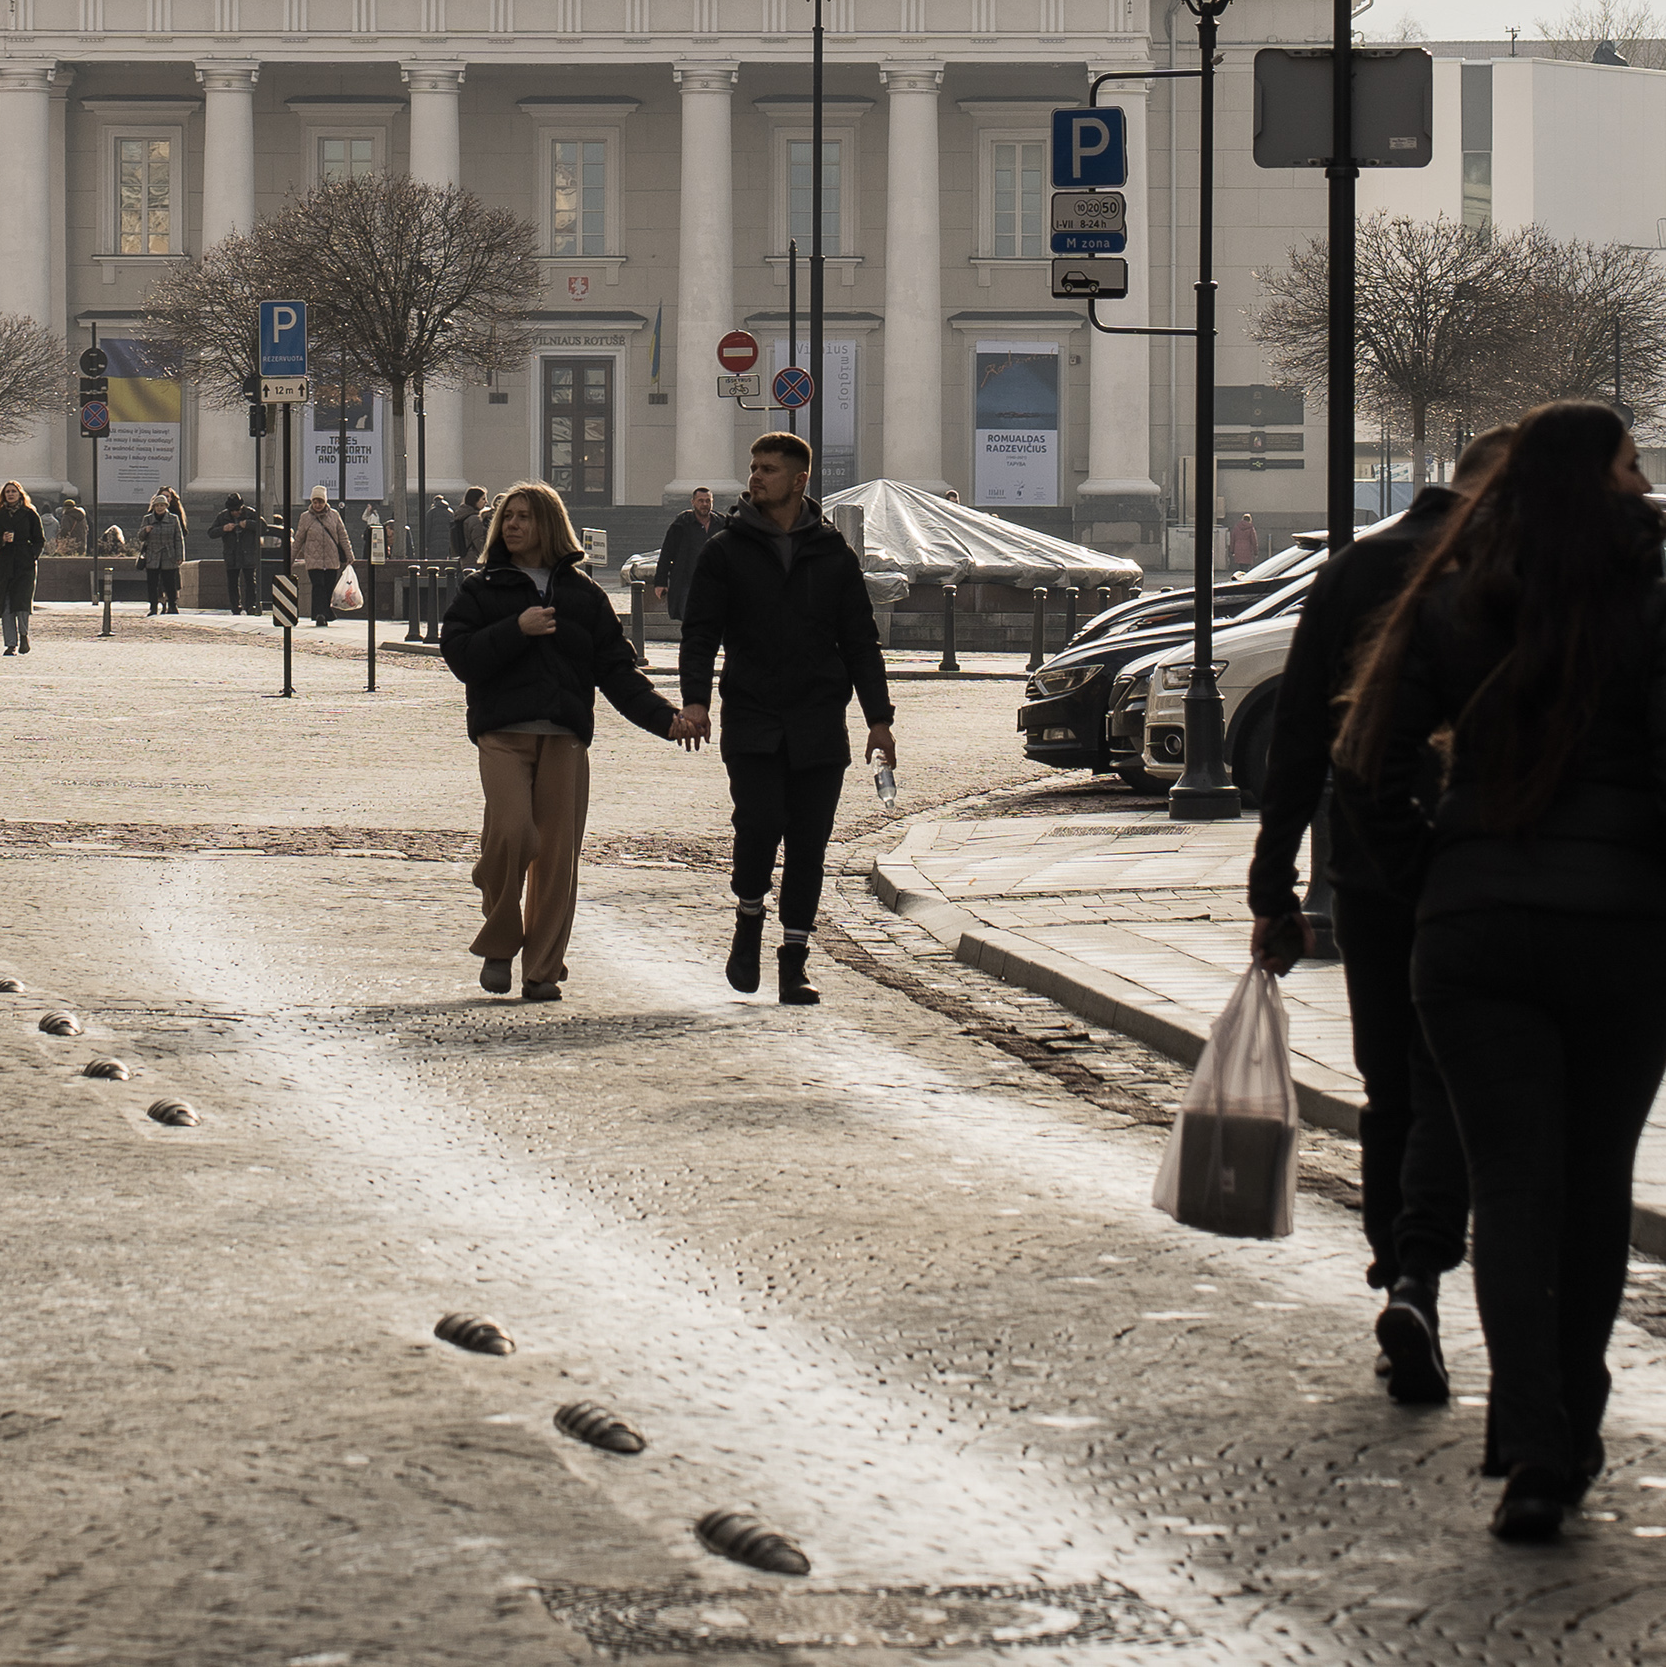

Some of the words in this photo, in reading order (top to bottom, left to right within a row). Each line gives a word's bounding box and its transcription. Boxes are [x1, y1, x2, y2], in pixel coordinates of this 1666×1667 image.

[1072, 117, 1110, 179] P
[1101, 202, 1117, 214] 50
[1056, 220, 1073, 228] I-VII
[1066, 238, 1077, 248] M
[1081, 240, 1110, 248] zona
[273, 306, 297, 344] P
[532, 336, 581, 346] VILNIAUS
[583, 334, 626, 346] ROTUŠĖ
[796, 342, 848, 354] Viius
[263, 355, 303, 363] REZERVUOTA
[837, 356, 851, 410] migloje
[275, 386, 284, 394] 12
[329, 436, 357, 445] TAES
[987, 434, 1045, 443] ROMUALDAS
[315, 446, 340, 454] FROM
[986, 442, 1047, 453] RADZEVIČIUS
[318, 456, 336, 464] AND
[345, 456, 368, 464] OUTH
